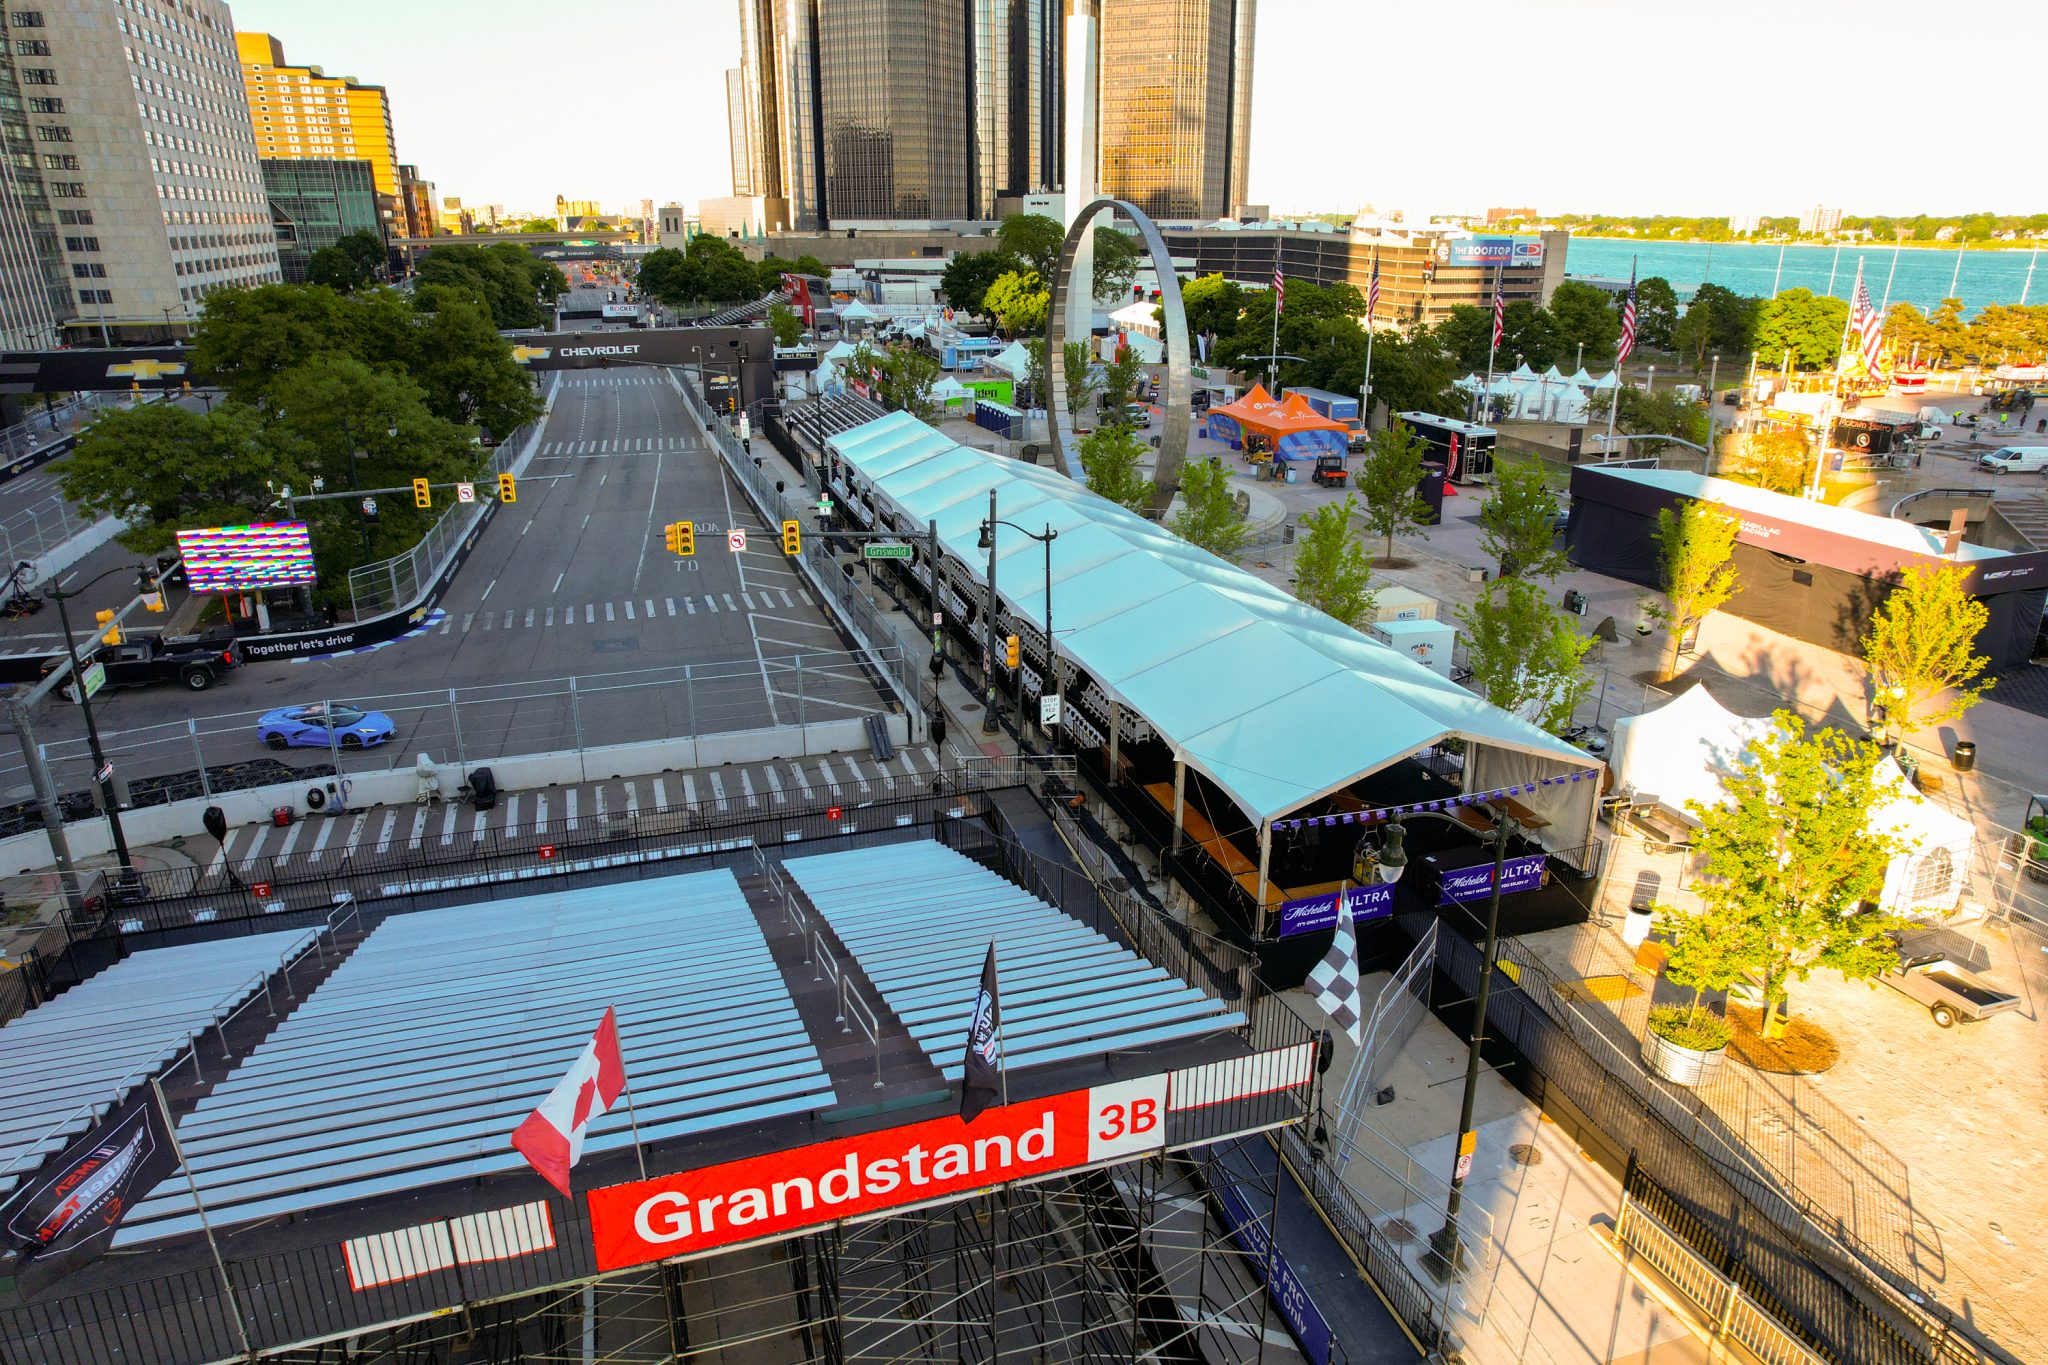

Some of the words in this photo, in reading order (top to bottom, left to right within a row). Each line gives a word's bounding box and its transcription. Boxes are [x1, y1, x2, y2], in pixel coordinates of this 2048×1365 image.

[1455, 247, 1468, 255] THE
[1468, 246, 1511, 256] ROOFTOP
[560, 345, 640, 357] CHEVROLET
[1740, 520, 1781, 536] CADILLAC
[870, 547, 906, 556] Griswold
[247, 641, 299, 655] Together
[300, 638, 324, 650] let's
[1443, 872, 1489, 891] Michelob
[1476, 886, 1492, 894] WORTH
[1283, 900, 1333, 920] Michelob
[1306, 918, 1319, 926] ONLY
[1319, 915, 1337, 923] WORTH
[1097, 1097, 1158, 1142] 3B
[633, 1110, 1056, 1245] Grandstand
[1282, 1270, 1305, 1310] FRC
[1283, 1292, 1307, 1335] Only
